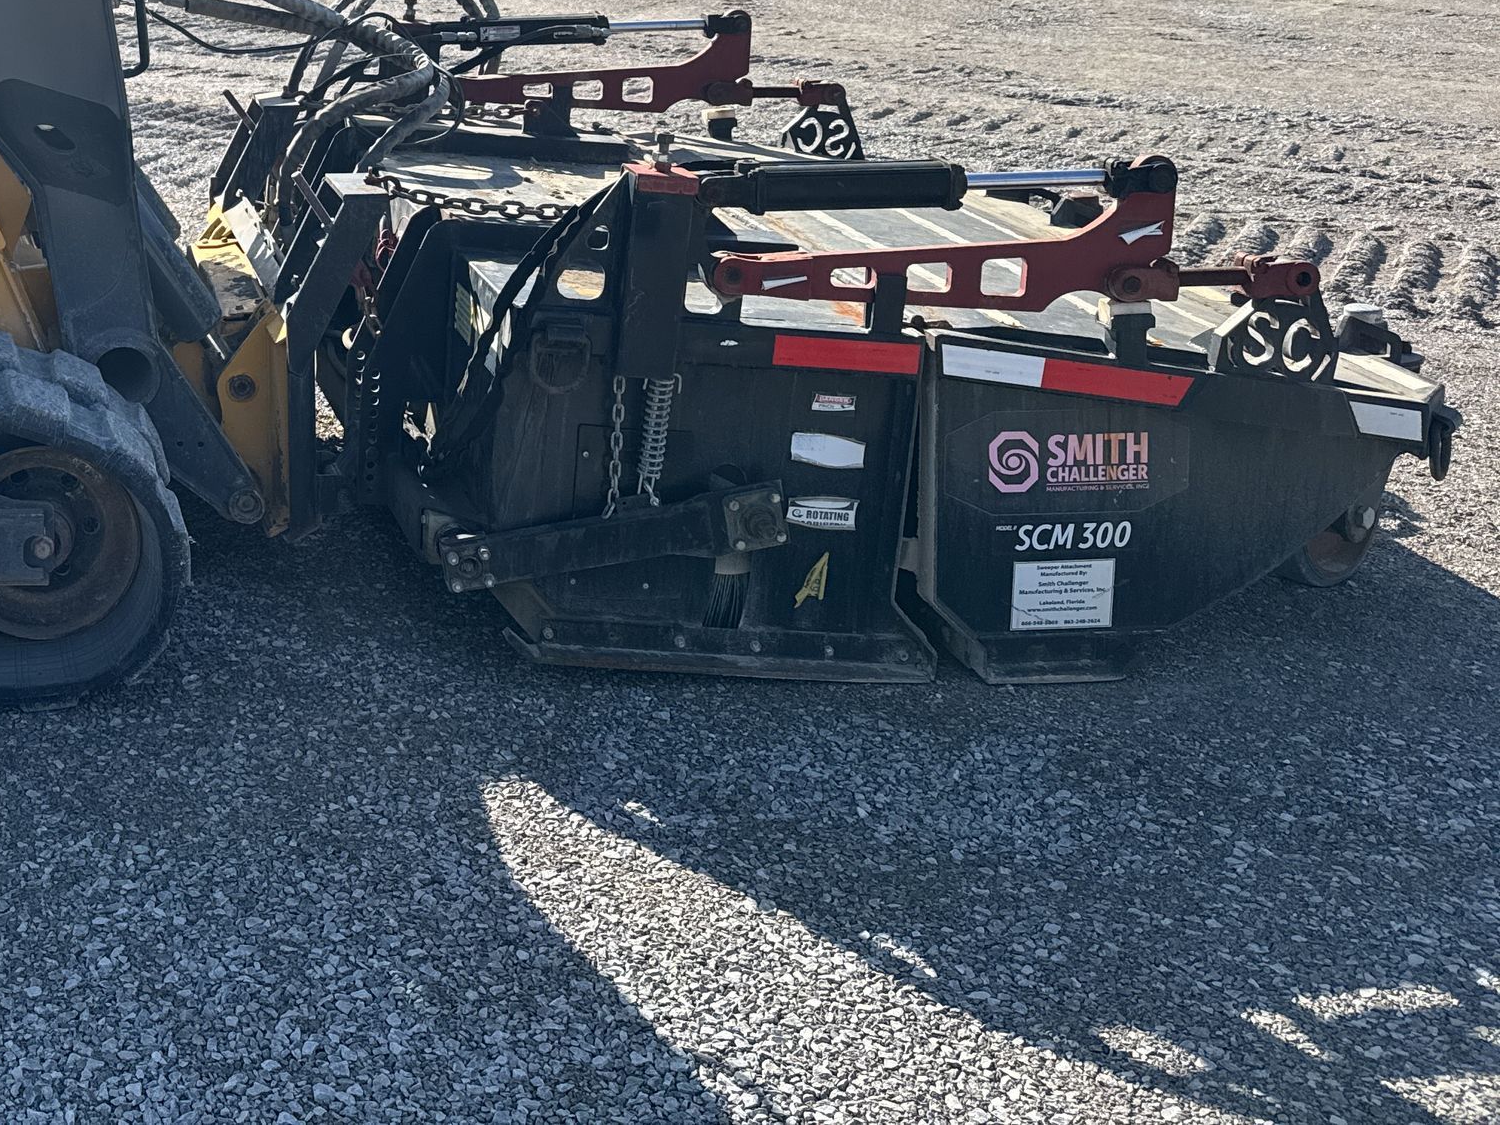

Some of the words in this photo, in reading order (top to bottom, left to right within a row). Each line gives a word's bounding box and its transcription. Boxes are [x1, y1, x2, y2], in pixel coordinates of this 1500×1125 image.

[1047, 431, 1149, 467] SMITH
[1046, 464, 1149, 483] CHALLENGER
[805, 509, 850, 522] ROTATING
[1014, 523, 1076, 552] SCM
[1077, 520, 1132, 550] 300
